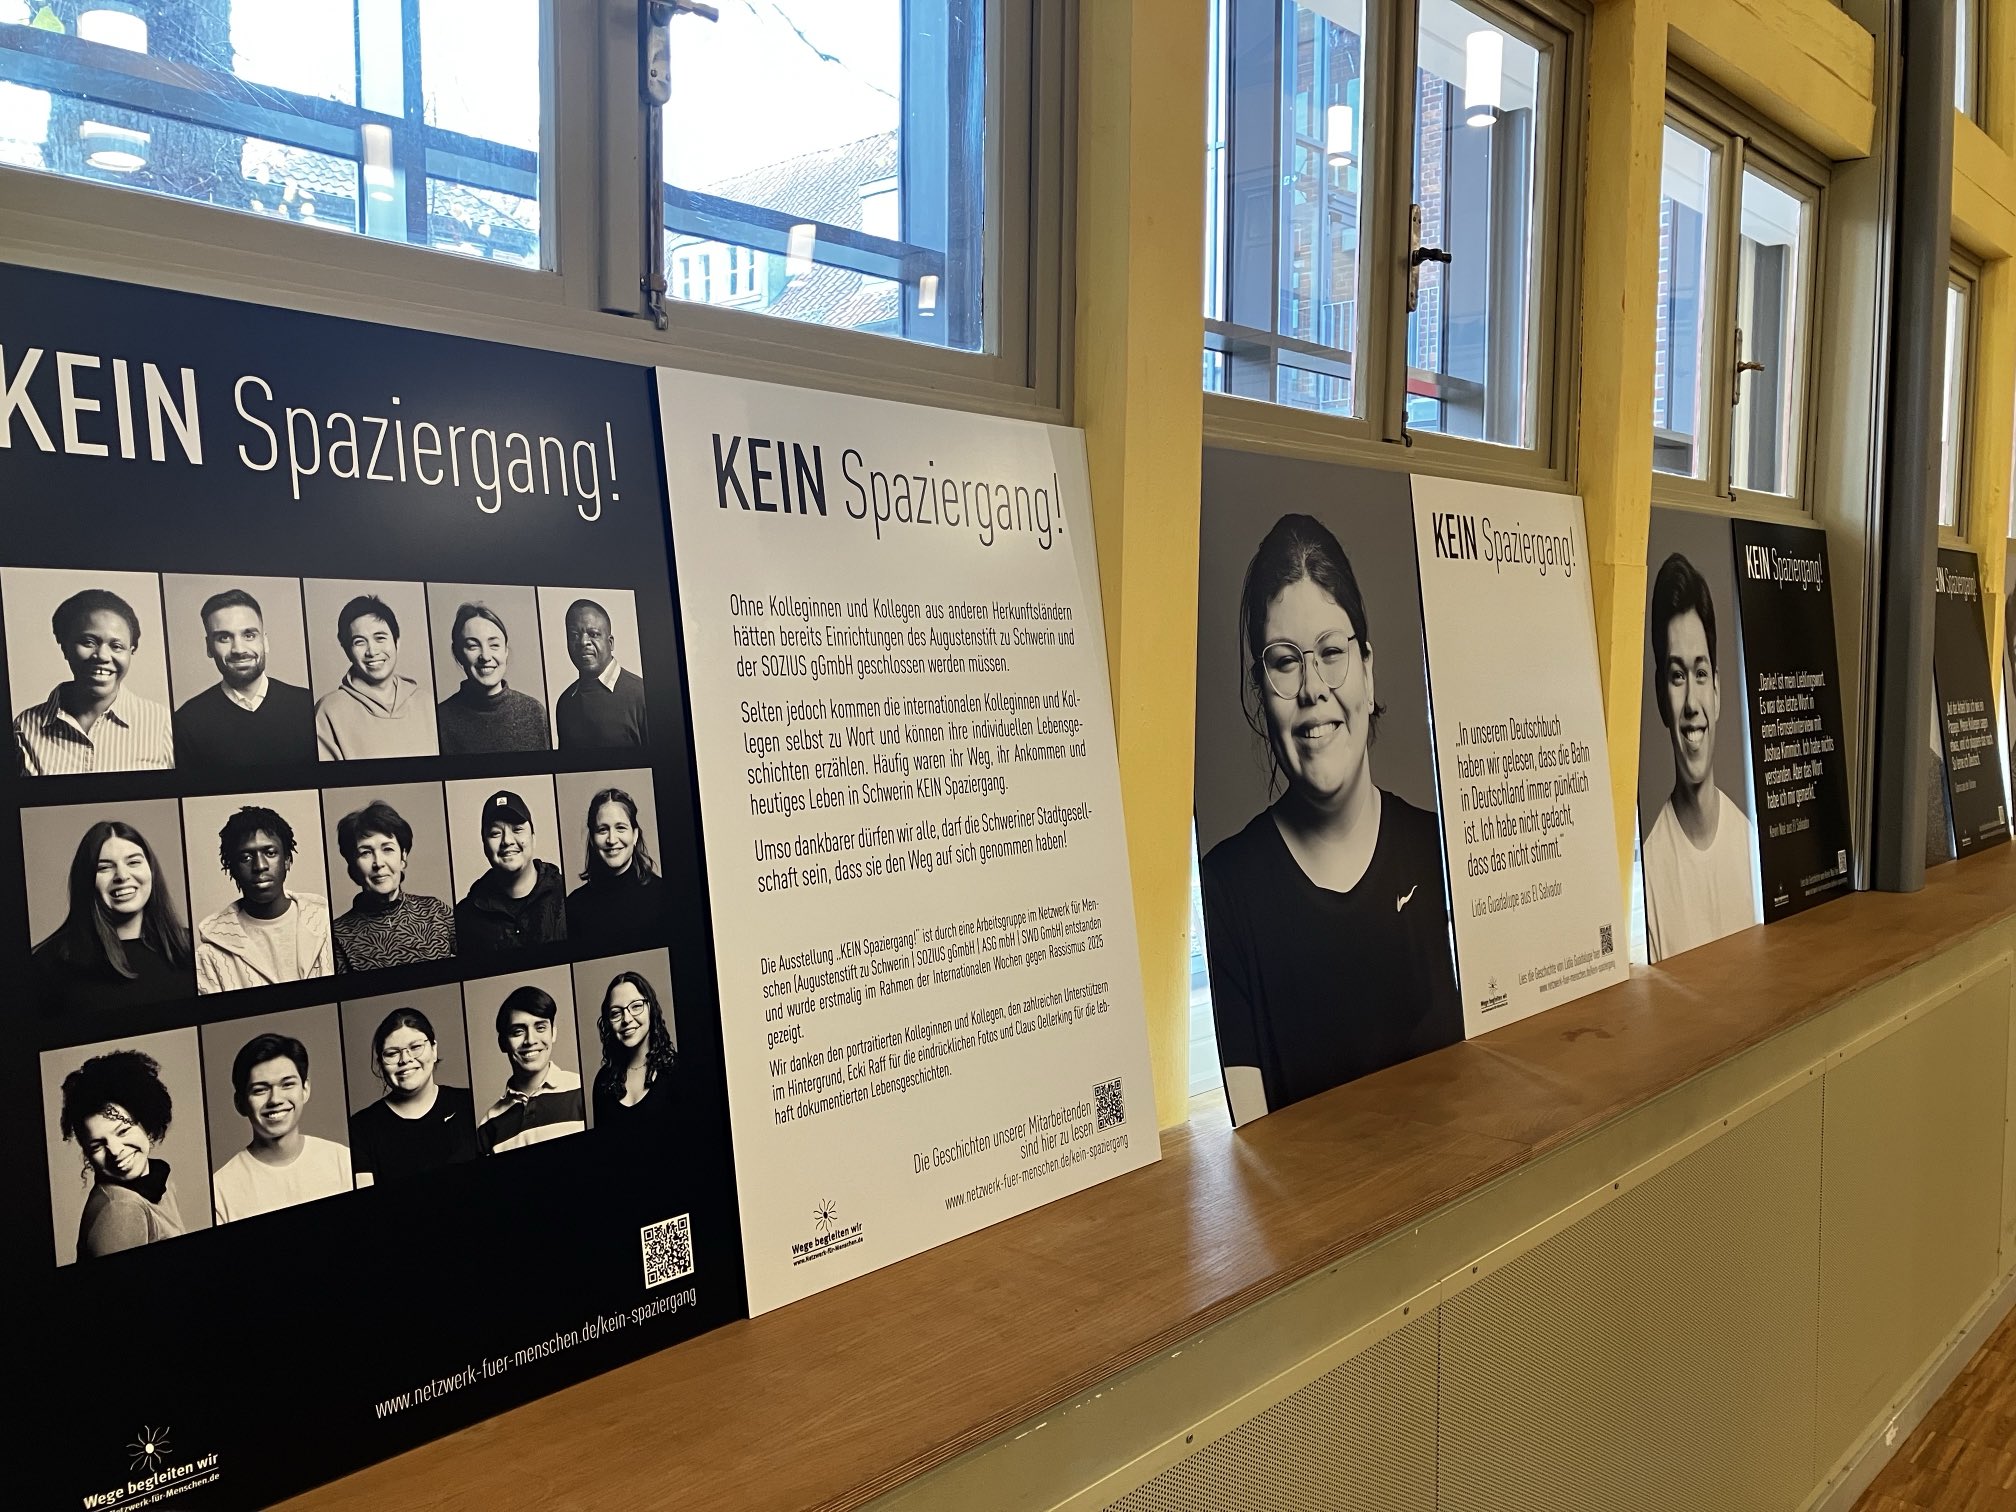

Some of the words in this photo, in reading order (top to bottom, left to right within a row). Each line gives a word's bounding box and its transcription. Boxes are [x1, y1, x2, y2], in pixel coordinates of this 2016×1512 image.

[0, 345, 203, 466] KEIN
[234, 375, 623, 522] Spaziergang!
[712, 434, 827, 516] KEIN
[842, 449, 1063, 550] Spaziergang!
[1432, 512, 1478, 560] KEIN
[1482, 518, 1576, 577] Spaziergang!
[1745, 544, 1770, 580] KEIN
[1772, 548, 1824, 592] Spaziergang!
[730, 593, 763, 615] Ohne
[769, 595, 841, 622] Kolleginnen
[846, 598, 868, 617] und
[872, 598, 920, 623] Kollegen
[925, 604, 944, 618] aus
[948, 601, 988, 619] anderen
[992, 601, 1072, 620] Herkunftsländern
[733, 625, 775, 646] hätten
[779, 625, 822, 646] bereits
[825, 625, 903, 651] Einrichtungen
[907, 626, 926, 646] des
[929, 627, 996, 650] Augustenstift
[999, 632, 1010, 645] zu
[1012, 627, 1055, 645] Schwerin
[1057, 628, 1074, 645] und
[736, 655, 757, 677] der
[761, 654, 806, 676] SOZIUS
[810, 654, 853, 680] gGmbH
[857, 654, 924, 679] geschlossen
[927, 653, 965, 672] werden
[968, 654, 1009, 672] müssen.
[740, 700, 782, 722] Selten
[786, 698, 826, 726] jedoch
[829, 698, 880, 718] kommen
[883, 696, 900, 716] die
[903, 694, 981, 714] internationalen
[983, 692, 1040, 714] Kolleginnen
[1042, 690, 1059, 708] und
[1061, 689, 1080, 707] Kol-
[743, 732, 779, 758] legen
[785, 729, 824, 750] selbst
[828, 732, 841, 748] zu
[845, 726, 875, 746] Wort
[879, 724, 900, 744] und
[904, 724, 944, 742] können
[948, 721, 968, 740] ihre
[972, 718, 1032, 738] individuellen
[1036, 716, 1082, 736] Lebensge-
[1470, 724, 1508, 744] unserem
[1509, 715, 1561, 740] Deutschbuch
[747, 761, 809, 784] schichten
[815, 756, 868, 778] erzählen.
[873, 752, 909, 776] Häufig
[913, 754, 945, 770] waren
[949, 748, 963, 767] ihr
[966, 746, 993, 769] Weg,
[996, 744, 1009, 763] ihr
[1014, 743, 1065, 761] Ankommen
[1069, 739, 1086, 757] und
[1456, 754, 1485, 778] haben
[1486, 751, 1499, 774] wir
[1502, 749, 1536, 778] gelesen,
[1538, 745, 1556, 768] dass
[1557, 743, 1569, 765] die
[1570, 741, 1590, 763] Bahn
[750, 791, 805, 817] heutiges
[808, 787, 844, 809] Leben
[847, 784, 859, 805] in
[862, 780, 913, 803] Schwerin
[916, 777, 941, 797] KEIN
[944, 775, 1007, 798] Spaziergang.
[1460, 787, 1470, 811] in
[1471, 780, 1525, 809] Deutschland
[1526, 778, 1551, 800] immer
[1553, 771, 1588, 801] pünktlich
[754, 839, 791, 861] Umso
[794, 832, 854, 856] dankbarer
[858, 825, 894, 847] dürfen
[896, 822, 913, 842] wir
[916, 820, 939, 840] alle,
[941, 815, 961, 837] darf
[964, 814, 979, 834] die
[981, 809, 1034, 831] Schweriner
[1036, 802, 1091, 826] Stadtgesell-
[1463, 820, 1479, 844] ist.
[1480, 816, 1494, 841] Ich
[1495, 813, 1517, 837] habe
[1518, 809, 1540, 833] nicht
[1541, 804, 1574, 834] gedacht,
[757, 866, 798, 892] schaft
[802, 863, 831, 886] sein,
[834, 860, 862, 880] dass
[865, 855, 882, 876] sie
[885, 853, 905, 873] den
[907, 849, 933, 872] Weg
[935, 844, 952, 866] auf
[955, 842, 976, 863] sich
[979, 839, 1033, 864] genommen
[1035, 830, 1066, 850] haben!
[1467, 852, 1488, 877] dass
[1490, 847, 1506, 872] das
[1507, 842, 1529, 867] nicht
[760, 957, 776, 974] Die
[778, 949, 833, 970] Ausstellung
[922, 928, 933, 943] ist
[934, 923, 956, 940] durch
[958, 920, 974, 936] eine
[976, 913, 1026, 932] Arbeitsgruppe
[1027, 908, 1037, 922] im
[1038, 902, 1070, 919] Netzwerk
[1070, 900, 1080, 913] für
[767, 1024, 803, 1049] gezeigt.
[913, 1152, 930, 1174] Die
[932, 1135, 990, 1166] Geschichten
[993, 1123, 1025, 1146] unserer
[1028, 1101, 1091, 1133] Mitarbeitenden
[1020, 1135, 1038, 1159] sind
[1040, 1132, 1056, 1151] hier
[1059, 1130, 1069, 1145] zu
[1070, 1122, 1093, 1141] lesen
[945, 1135, 1128, 1208] www.netzwerk-fuer-menschen.de/kein-spaziergang
[791, 1241, 813, 1254] Wege
[814, 1228, 849, 1246] begleiten
[850, 1222, 862, 1233] wir
[374, 1286, 698, 1420] www.netzwerk-fuer-menschen.de/kein-spaziergang
[83, 1487, 124, 1510] Wege
[127, 1463, 194, 1495] begleiten
[196, 1453, 219, 1469] wir
